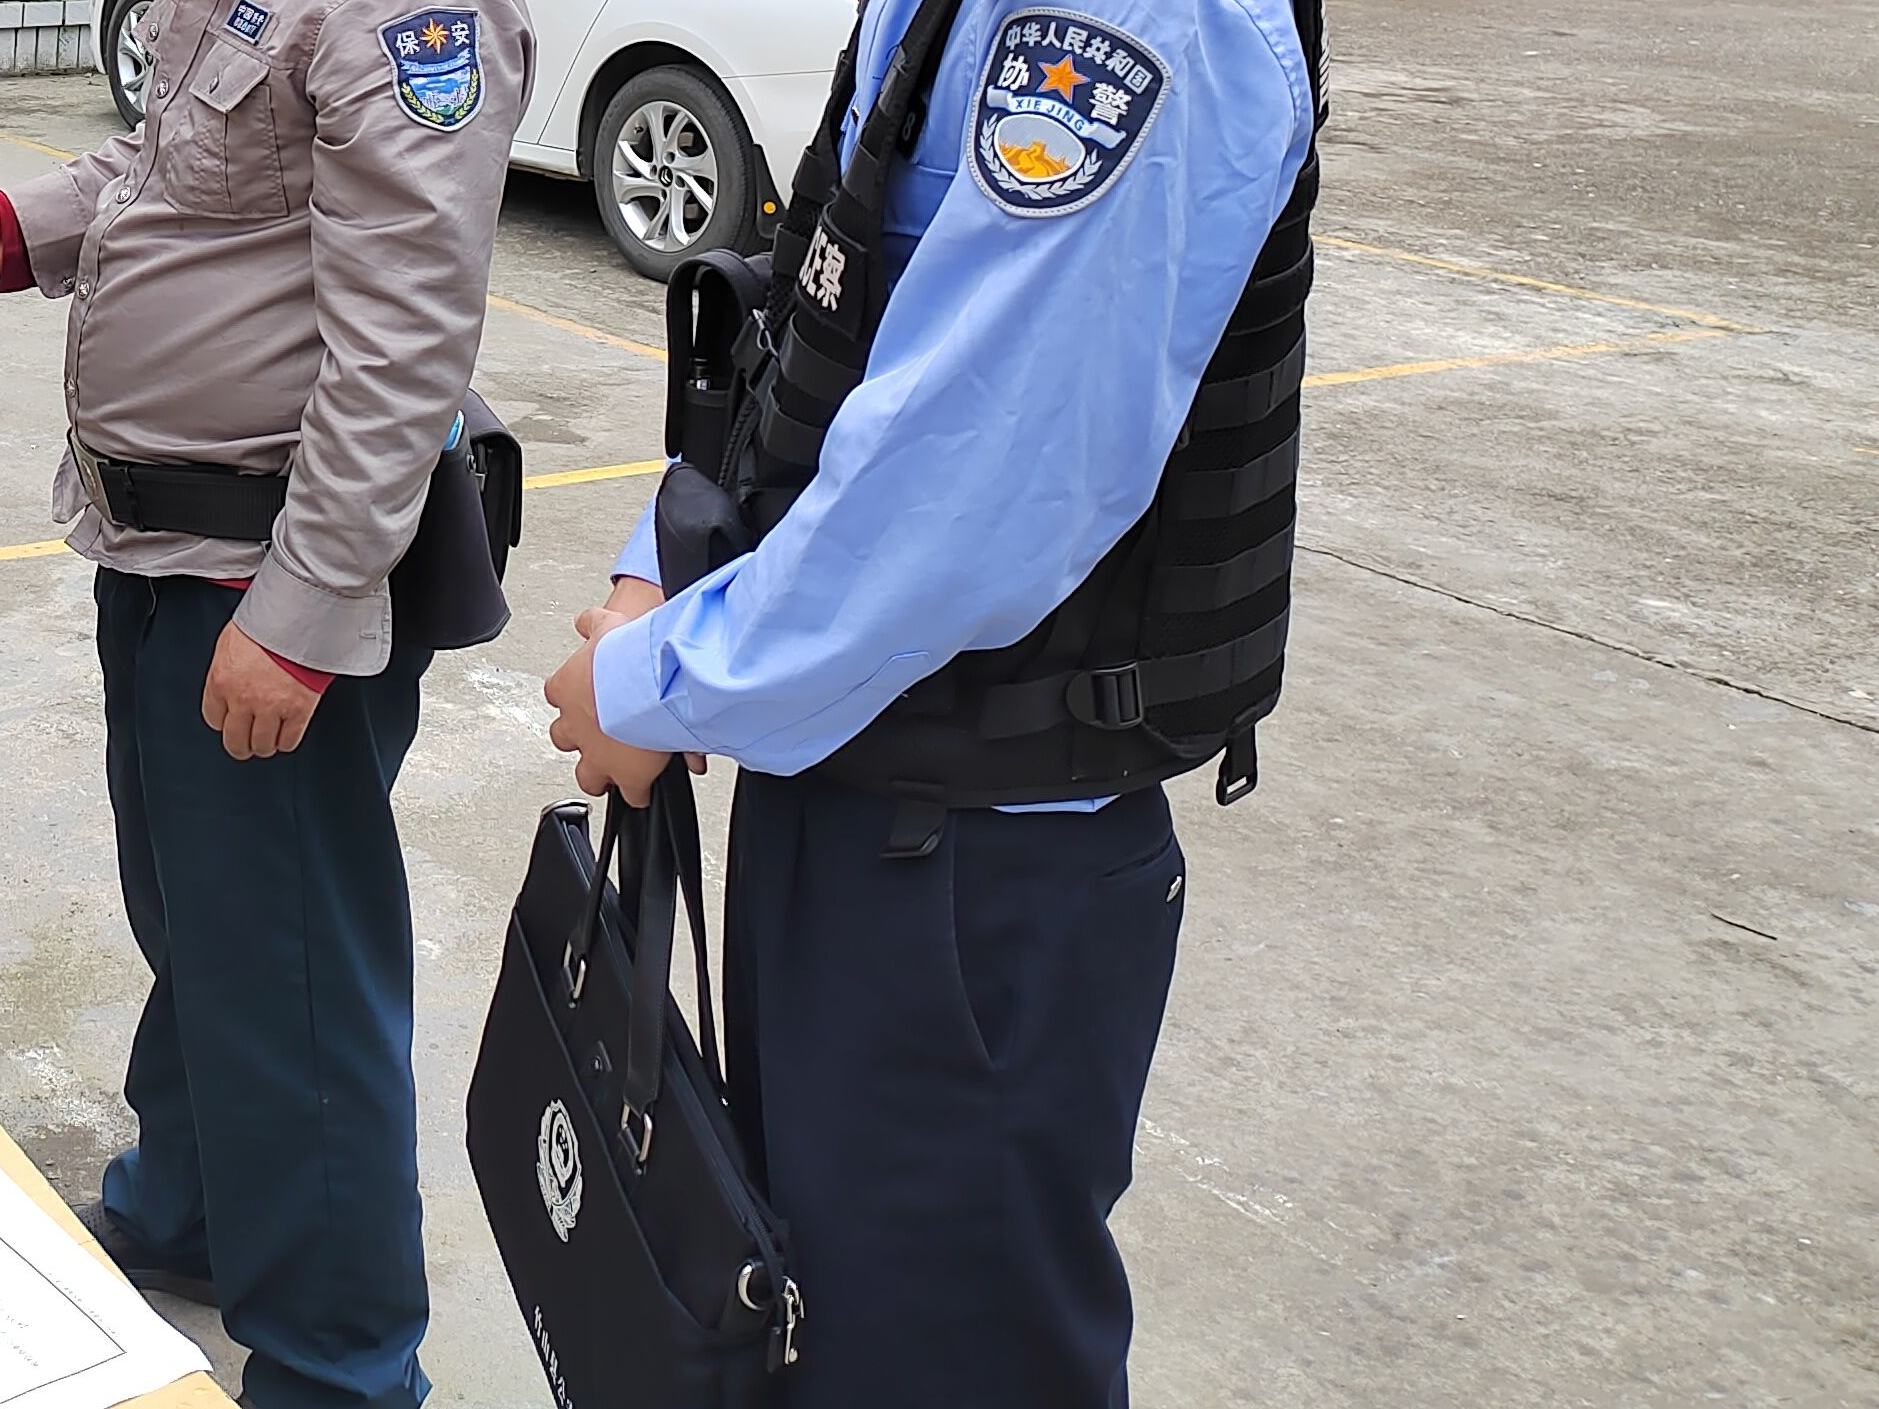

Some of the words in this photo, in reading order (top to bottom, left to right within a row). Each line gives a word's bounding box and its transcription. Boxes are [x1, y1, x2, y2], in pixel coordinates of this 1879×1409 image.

[396, 31, 420, 58] 保
[451, 20, 470, 47] 安
[1005, 21, 1155, 95] 中华人民共和国
[997, 52, 1031, 91] 协
[1088, 82, 1133, 126] 警
[1015, 98, 1042, 111] XIE
[1046, 102, 1085, 132] JING
